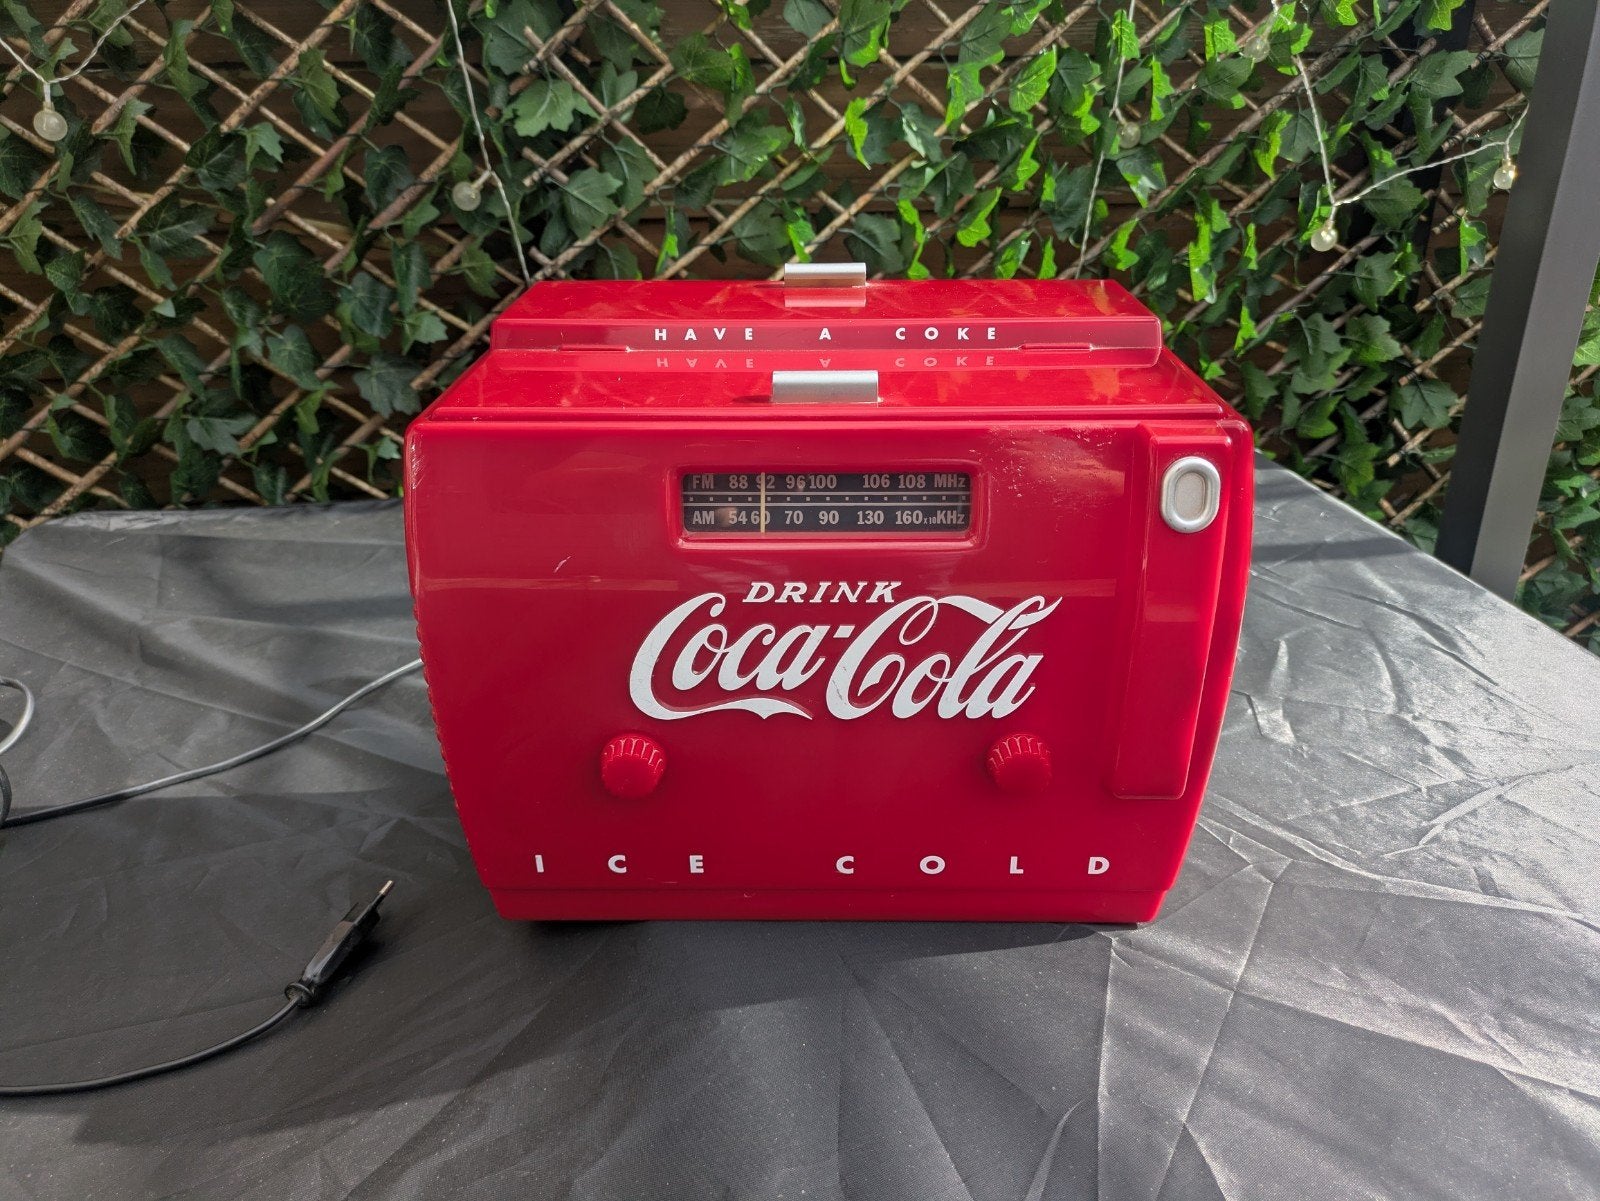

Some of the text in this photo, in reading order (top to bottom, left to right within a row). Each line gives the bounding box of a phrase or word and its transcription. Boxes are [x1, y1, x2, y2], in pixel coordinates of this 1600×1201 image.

[654, 327, 996, 342] HAVE A COKE
[692, 474, 714, 489] FM
[728, 474, 748, 489] 88
[785, 474, 806, 490] 96
[809, 474, 837, 489] 100
[862, 474, 890, 489] 106
[898, 474, 926, 489] 108
[934, 473, 966, 488] MHz
[692, 510, 715, 525] AM
[728, 510, 748, 525] 54
[784, 510, 804, 525] 70
[818, 510, 840, 525] 90
[857, 510, 885, 525] 130
[895, 510, 923, 525] 160
[741, 580, 902, 604] DRINK
[629, 592, 1063, 721] Coca-Cola
[534, 854, 1110, 875] ICE COLD
